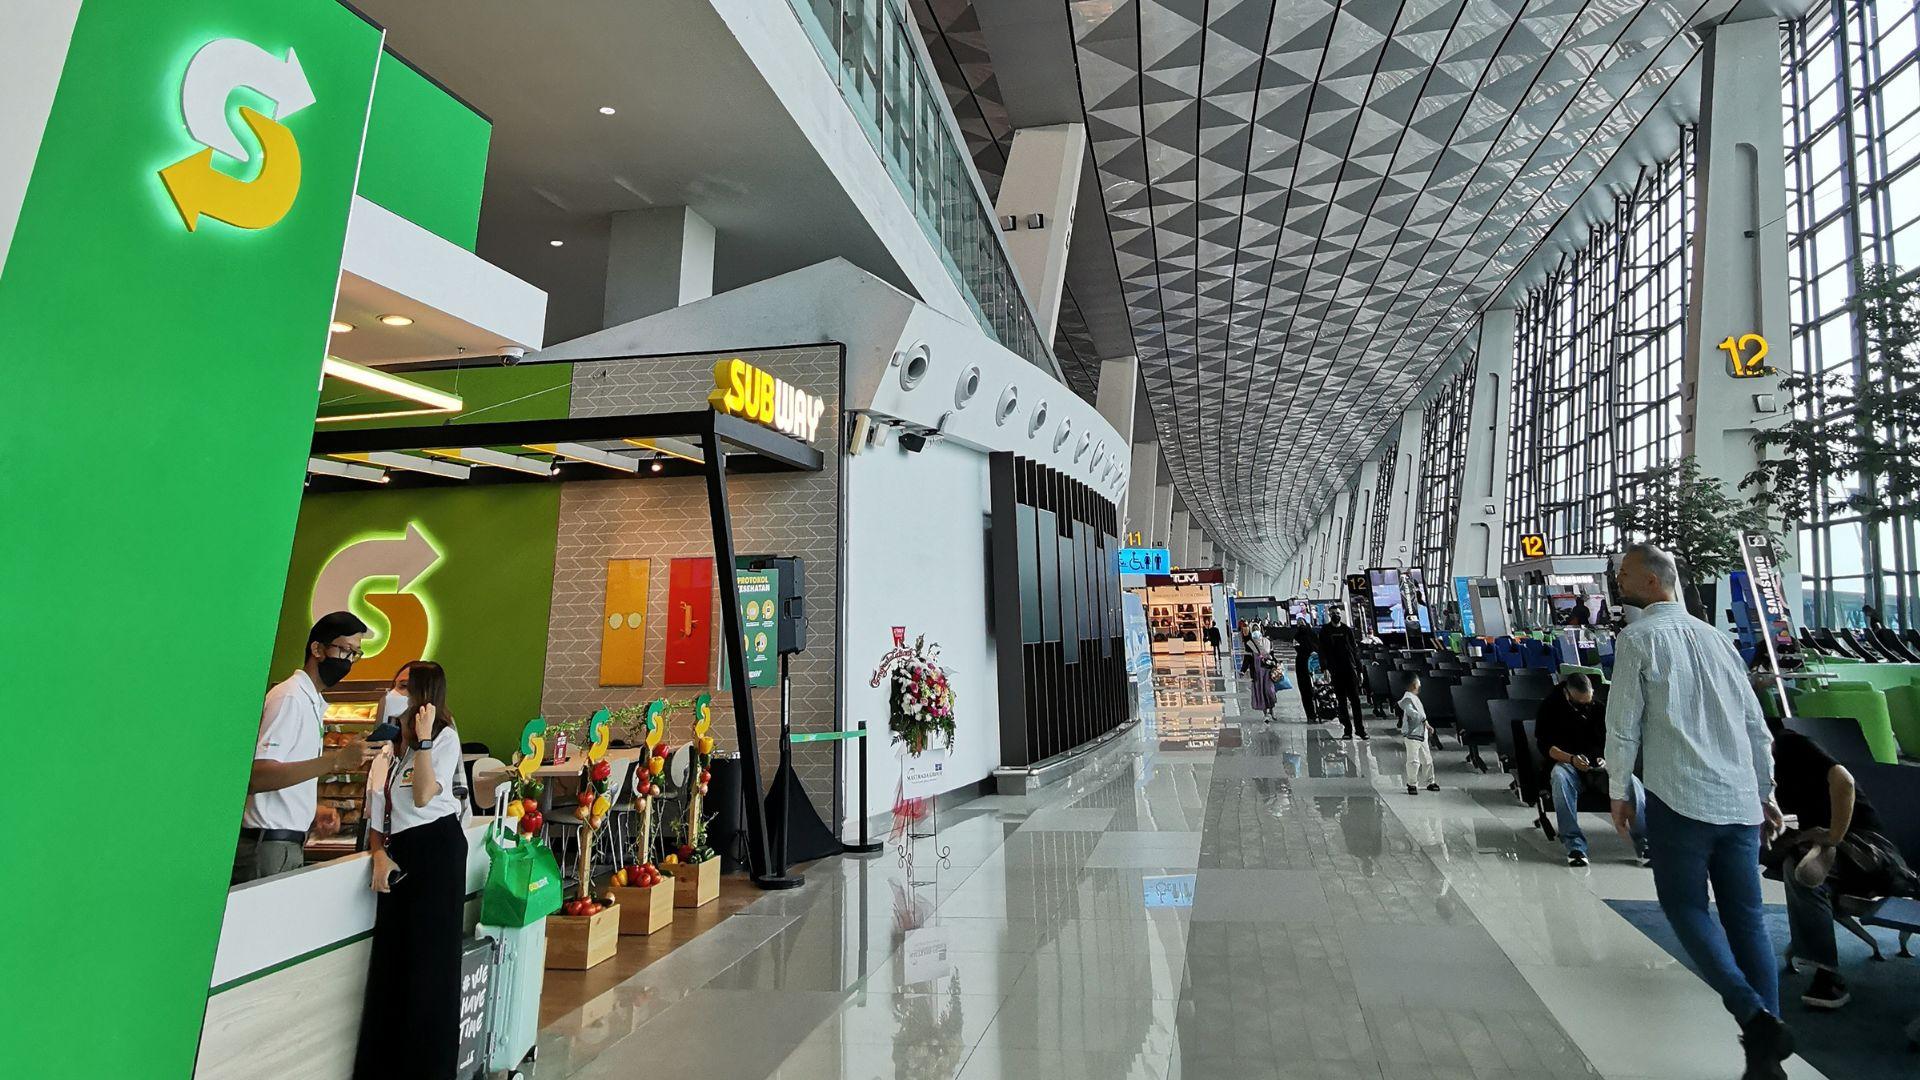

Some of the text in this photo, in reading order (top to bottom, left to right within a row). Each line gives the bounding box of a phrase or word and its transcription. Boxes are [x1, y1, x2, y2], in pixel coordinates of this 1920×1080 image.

[1718, 333, 1776, 376] 12
[723, 358, 825, 443] SUBWAY
[1127, 531, 1142, 546] 11
[1521, 536, 1545, 556] 12
[737, 576, 769, 585] PROTOKOL
[1350, 577, 1367, 590] 12
[1754, 556, 1780, 615] SAMSUNG
[460, 987, 486, 1018] HAVE
[459, 1011, 484, 1044] TIME
